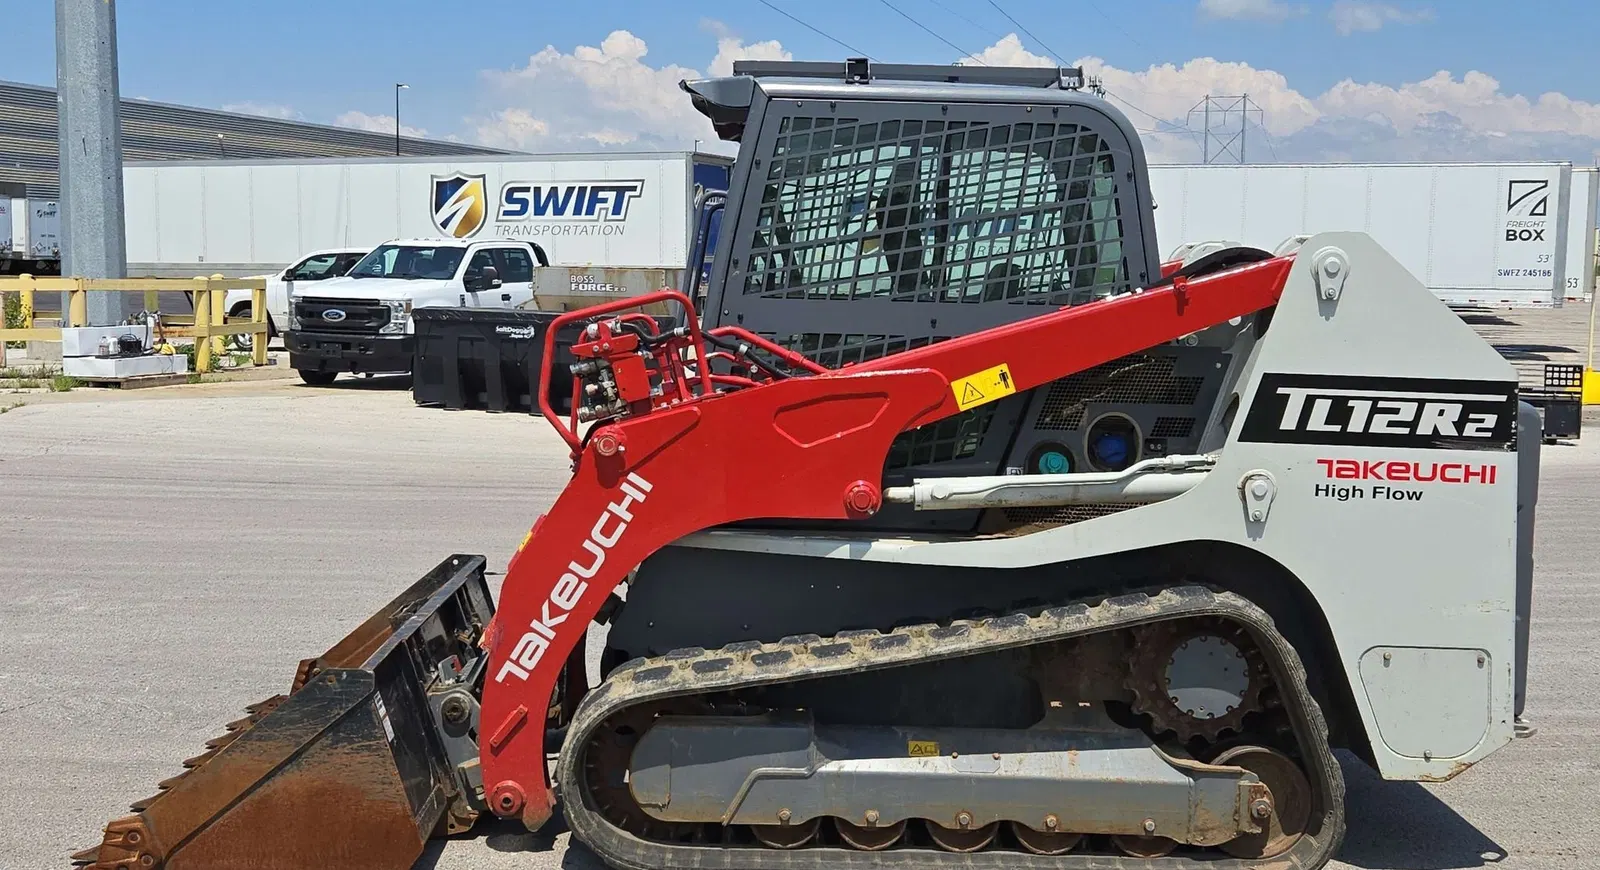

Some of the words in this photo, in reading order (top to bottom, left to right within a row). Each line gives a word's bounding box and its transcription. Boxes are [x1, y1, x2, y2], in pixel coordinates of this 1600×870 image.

[501, 184, 639, 217] SWIFT
[495, 224, 625, 236] TRANSPORTATION
[1506, 220, 1546, 228] FREIGHT
[1505, 228, 1546, 242] BOX
[1497, 269, 1520, 277] SWFZ
[570, 275, 595, 284] BOSS
[571, 283, 614, 292] FORGE
[1276, 387, 1508, 438] TL12R2
[1314, 484, 1364, 501] High
[1372, 486, 1424, 501] Flow
